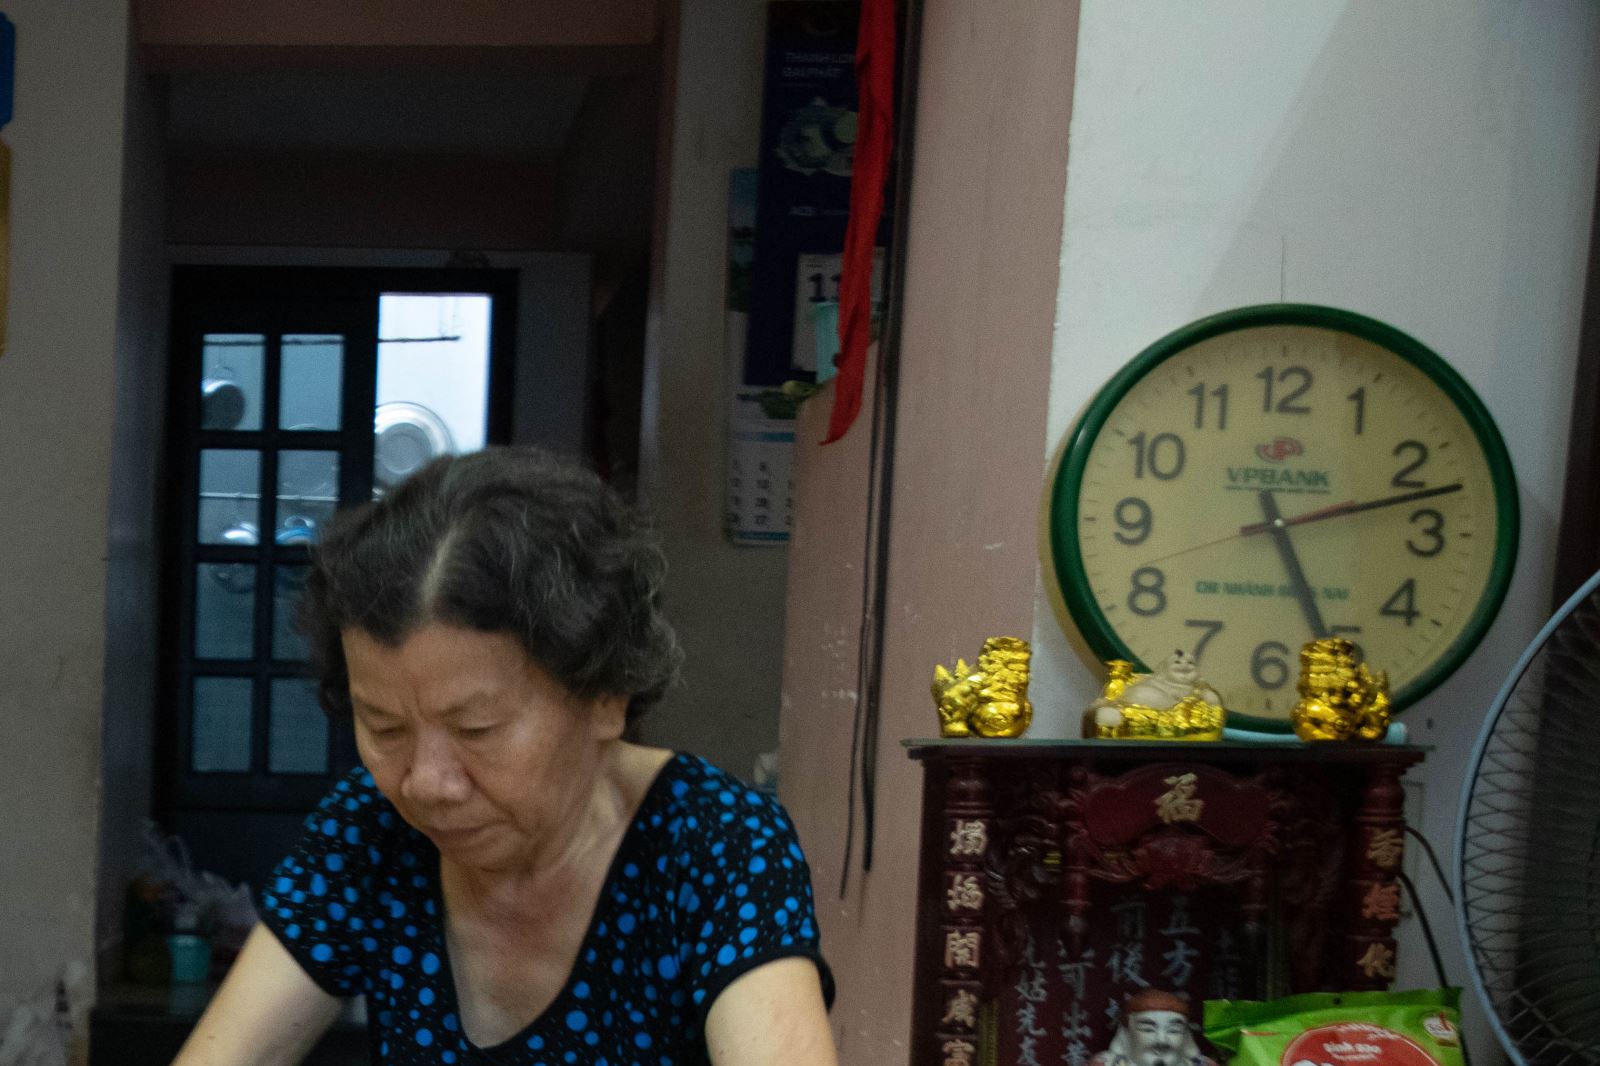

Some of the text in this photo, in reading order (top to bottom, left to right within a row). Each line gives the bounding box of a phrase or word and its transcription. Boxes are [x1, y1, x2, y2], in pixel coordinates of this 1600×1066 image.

[1188, 382, 1231, 430] 11
[1255, 366, 1314, 415] 12
[1347, 387, 1366, 435] 1
[1129, 432, 1187, 480] 10
[1225, 467, 1331, 487] VPBANK
[1391, 440, 1429, 488] 2
[1113, 498, 1153, 546] 9
[1406, 509, 1446, 557] 3
[1127, 567, 1167, 617] 8
[1379, 578, 1420, 626] 4
[1184, 619, 1224, 661] 7
[1250, 640, 1290, 690] 6
